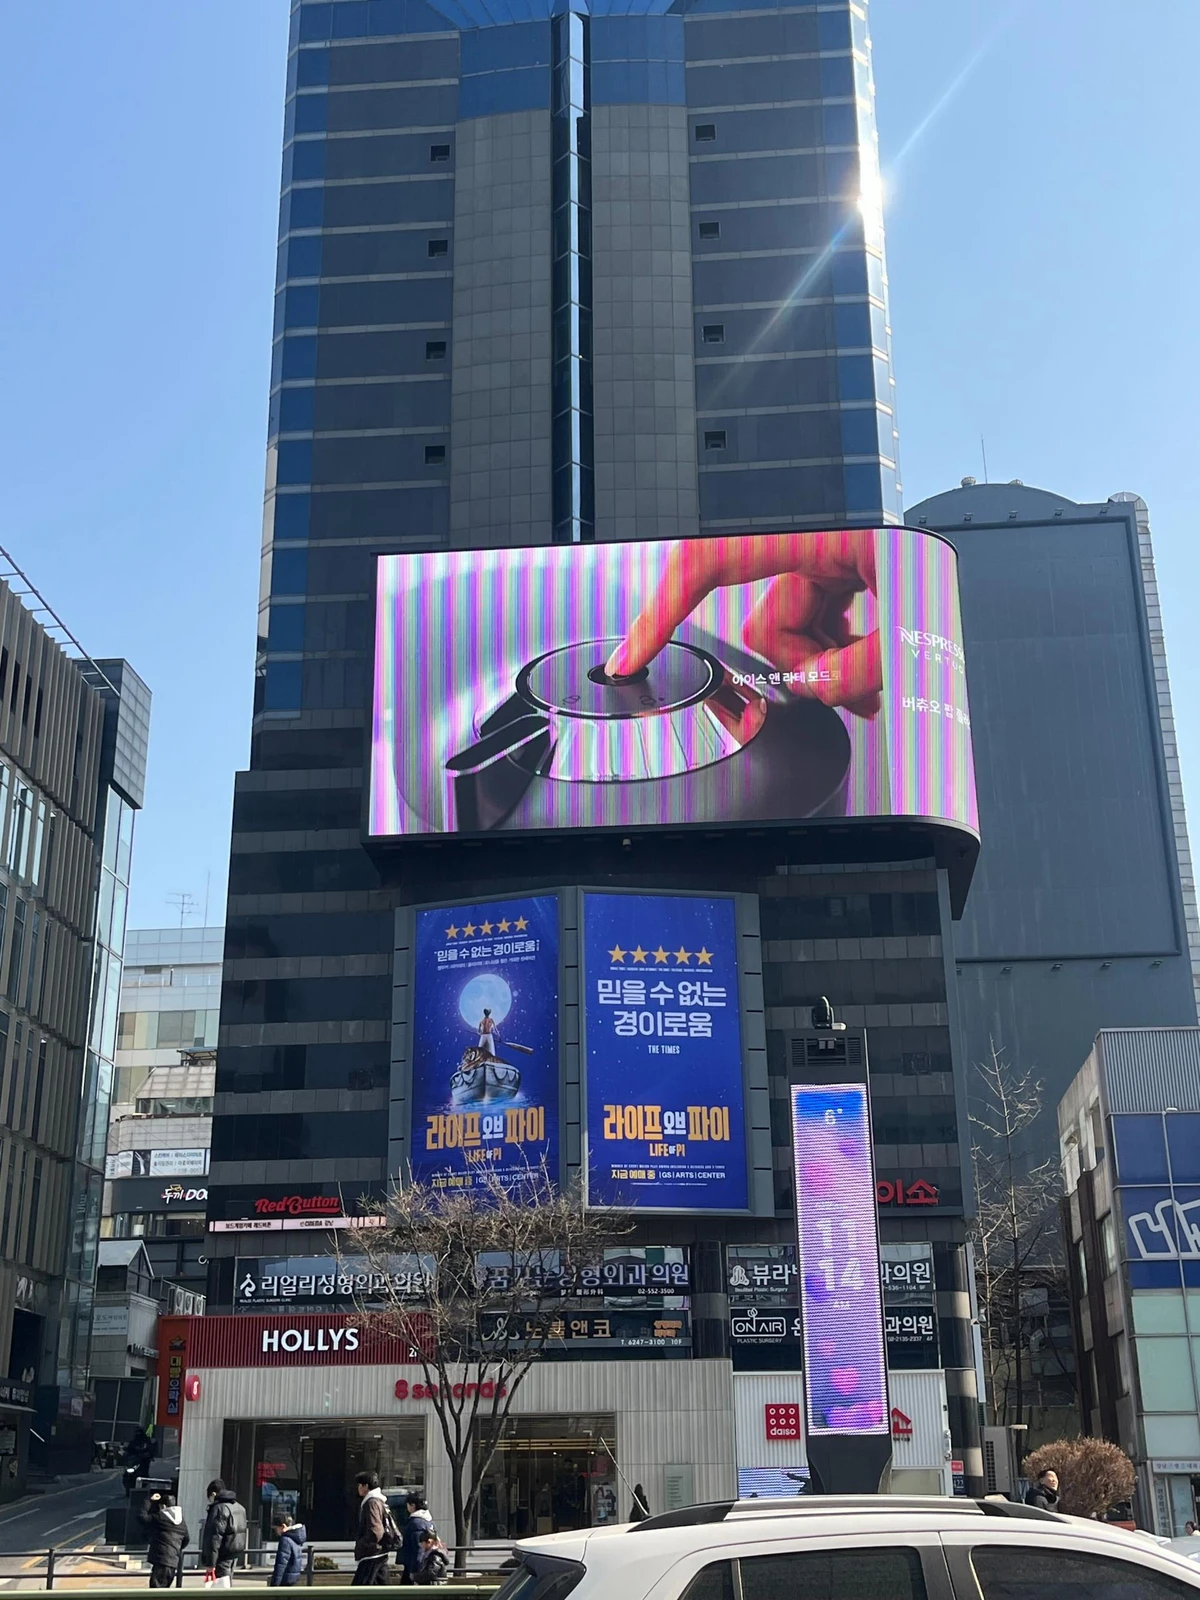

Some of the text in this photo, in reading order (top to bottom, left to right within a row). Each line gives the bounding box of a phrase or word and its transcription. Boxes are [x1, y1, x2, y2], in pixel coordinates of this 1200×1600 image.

[732, 673, 767, 686] 아이스
[768, 672, 781, 685] 앤
[783, 671, 806, 684] 라테
[902, 696, 941, 714] 버츄오
[459, 947, 470, 959] 수
[470, 945, 492, 958] 없는
[597, 979, 727, 1007] 믿을 수 없는
[613, 1010, 713, 1037] 경이로움
[647, 1044, 681, 1055] THE TIMES
[425, 1106, 545, 1150] 라이프 오브 파이
[603, 1104, 730, 1141] 라이프 오브 파이
[493, 1147, 502, 1160] PI
[649, 1143, 686, 1157] LIFE OF PI
[611, 1169, 629, 1180] 지금
[629, 1169, 646, 1180] 예매
[162, 1188, 183, 1204] 두끼
[255, 1196, 341, 1214] Red Button
[758, 1322, 783, 1333] AIR
[262, 1329, 359, 1353] HOLLYS
[395, 1379, 409, 1400] 8
[770, 1427, 797, 1436] daiso
